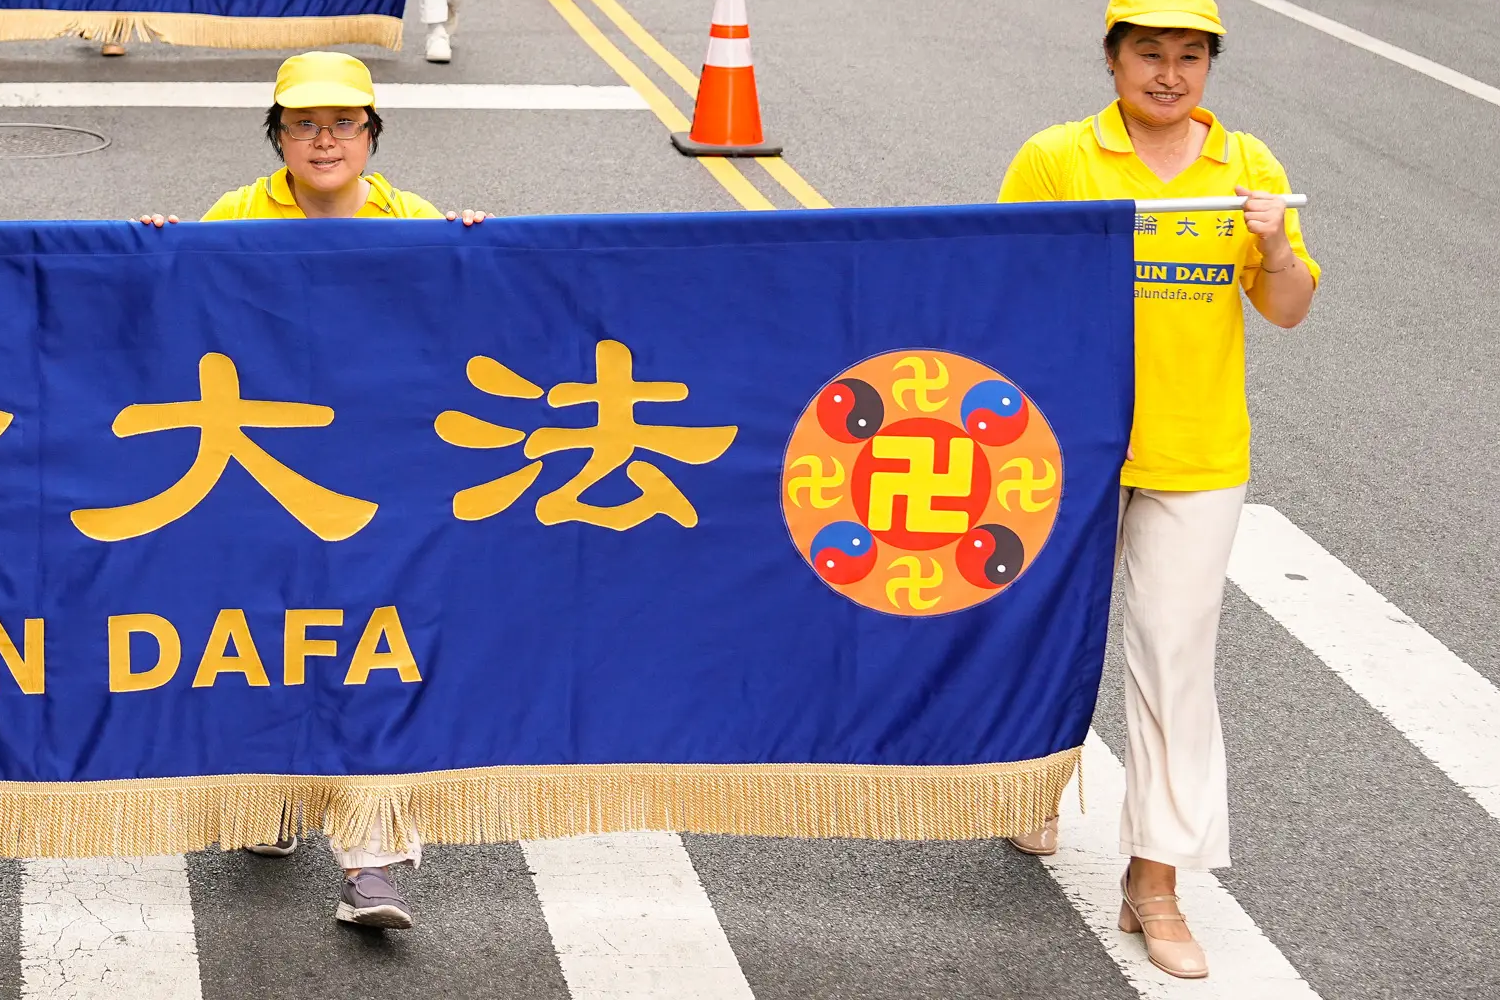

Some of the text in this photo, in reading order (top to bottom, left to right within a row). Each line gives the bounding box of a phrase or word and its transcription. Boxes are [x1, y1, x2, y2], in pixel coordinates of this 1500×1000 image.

[1175, 265, 1230, 283] DAFA
[1134, 286, 1215, 304] alundafa.org
[107, 604, 424, 694] DAFA
